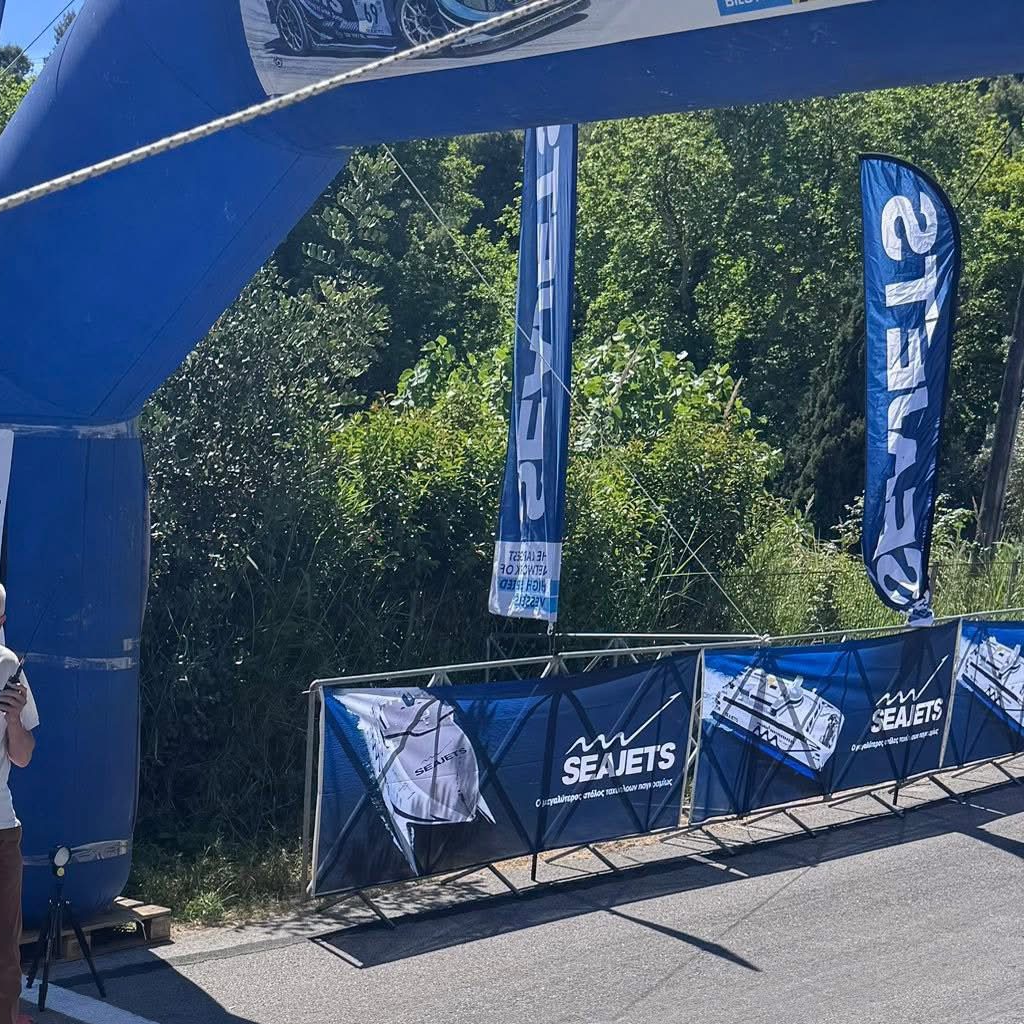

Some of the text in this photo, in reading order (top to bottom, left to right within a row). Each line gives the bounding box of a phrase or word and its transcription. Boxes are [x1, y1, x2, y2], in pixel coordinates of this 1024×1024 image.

[871, 698, 944, 734] SEAJETS
[415, 747, 468, 777] SEAJETS
[561, 742, 676, 787] SEAJETS
